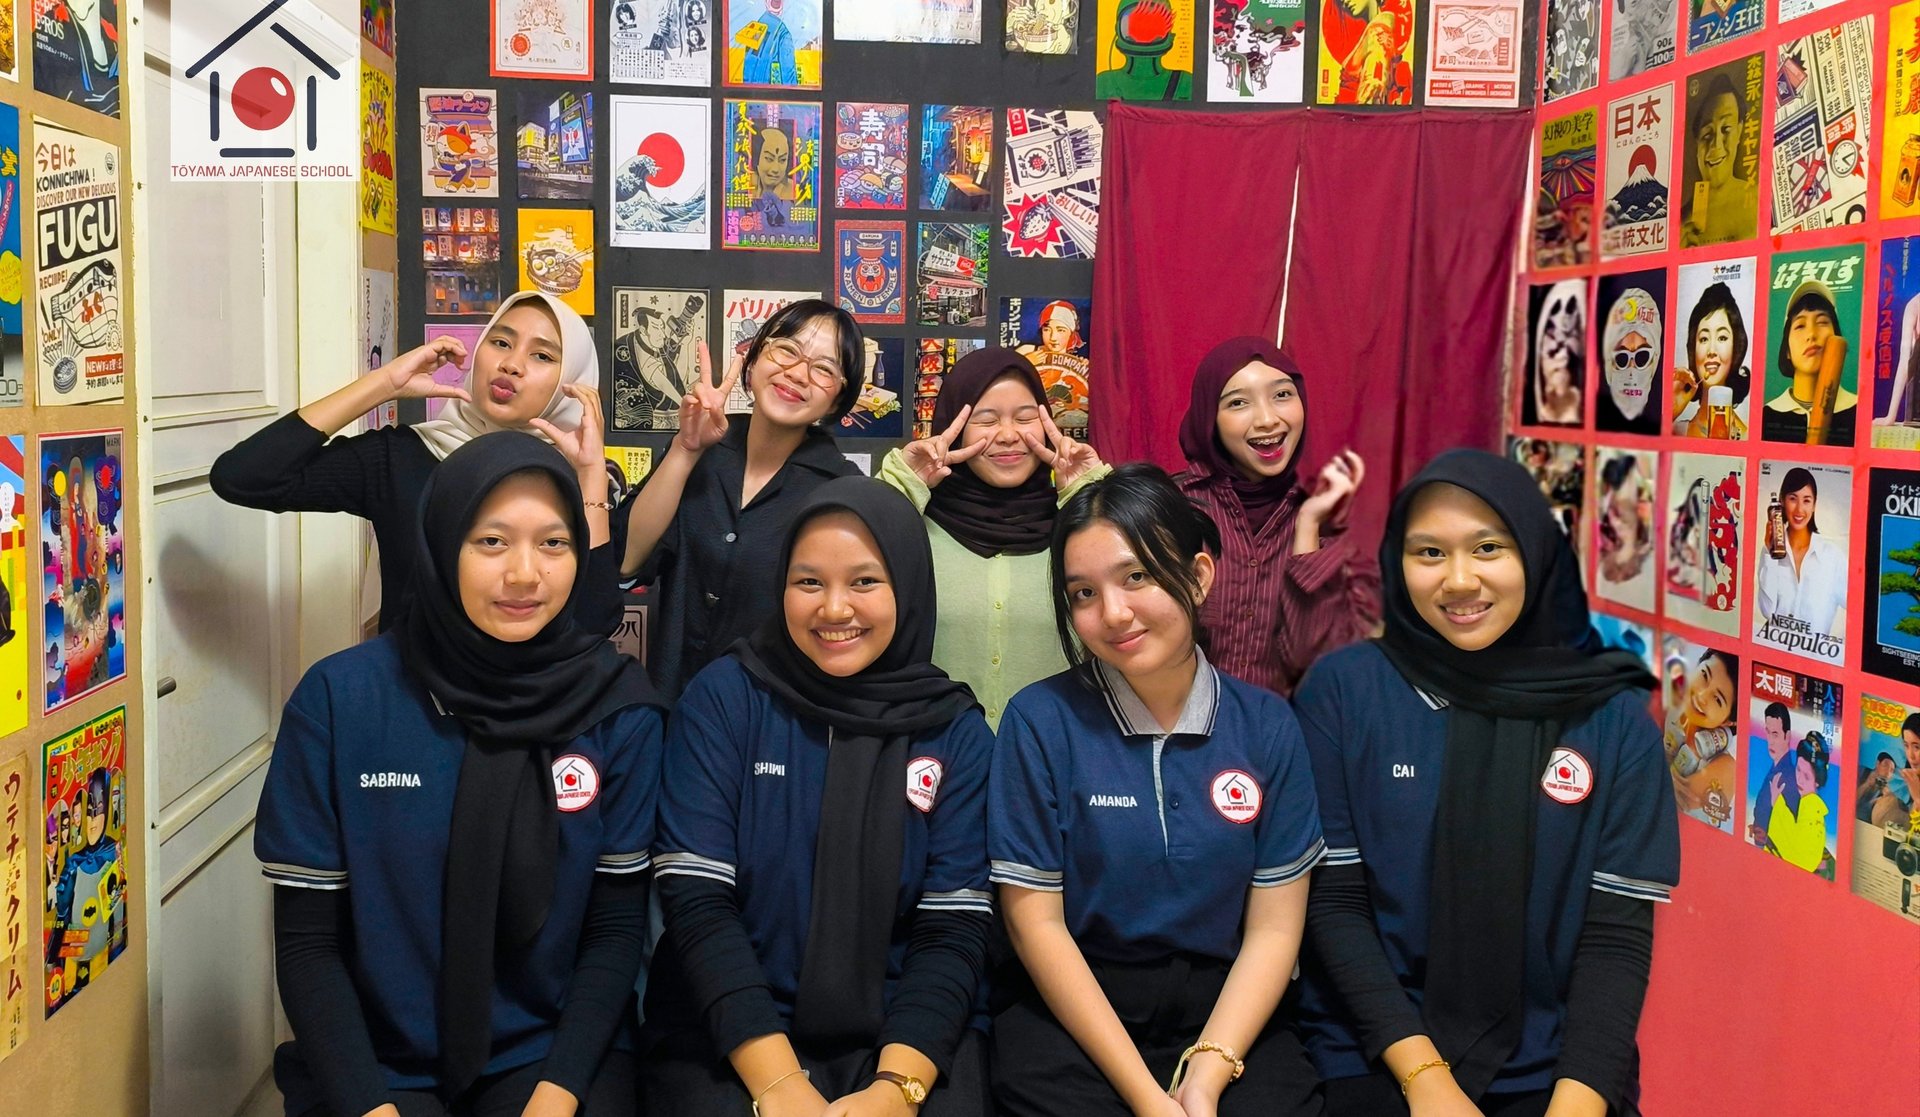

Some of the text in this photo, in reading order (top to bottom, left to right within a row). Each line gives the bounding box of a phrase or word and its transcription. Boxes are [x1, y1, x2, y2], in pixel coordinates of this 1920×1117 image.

[361, 16, 392, 50] TOKYO
[1858, 43, 1865, 53] DE
[1823, 65, 1831, 95] DIMANCHE
[1836, 36, 1845, 59] OUVERT
[1844, 88, 1852, 107] JOURS
[1859, 80, 1865, 93] DU
[1614, 95, 1661, 139] 日本
[1861, 97, 1870, 125] JAPON
[859, 108, 886, 175] 寿司
[1616, 131, 1659, 149] にほんのこころ
[1783, 141, 1792, 163] PLACE
[1790, 136, 1801, 159] SUR
[1800, 127, 1816, 153] OU
[35, 142, 77, 173] 今日は
[1017, 154, 1029, 178] イチゴ
[1045, 144, 1057, 174] POCKY
[36, 168, 90, 193] KONNICHIWA
[36, 182, 116, 209] DISCOVER OUR NEW DELICIOUS
[837, 187, 845, 207] 日本
[1780, 193, 1788, 218] PARIS
[1783, 175, 1792, 214] VOLTAIRE
[39, 198, 116, 268] FUGU
[1720, 263, 1742, 274] サッポロ
[1772, 255, 1862, 290] 好きです
[844, 272, 864, 302] RAMEN
[877, 272, 897, 302] TEMPLE
[726, 296, 790, 320] バリバ
[43, 327, 61, 344] ONLY
[1008, 298, 1022, 348] キリンビール
[1885, 494, 1920, 518] OKI
[1771, 612, 1812, 635] NESCAFÉ
[1756, 619, 1840, 659] Acapulco
[1755, 670, 1794, 699] 太陽
[360, 772, 421, 788] SABRINA
[1392, 764, 1415, 778] CAI
[1089, 794, 1138, 808] AMANDA
[4, 771, 21, 864] ウテナ
[6, 893, 23, 1001] クリーム
